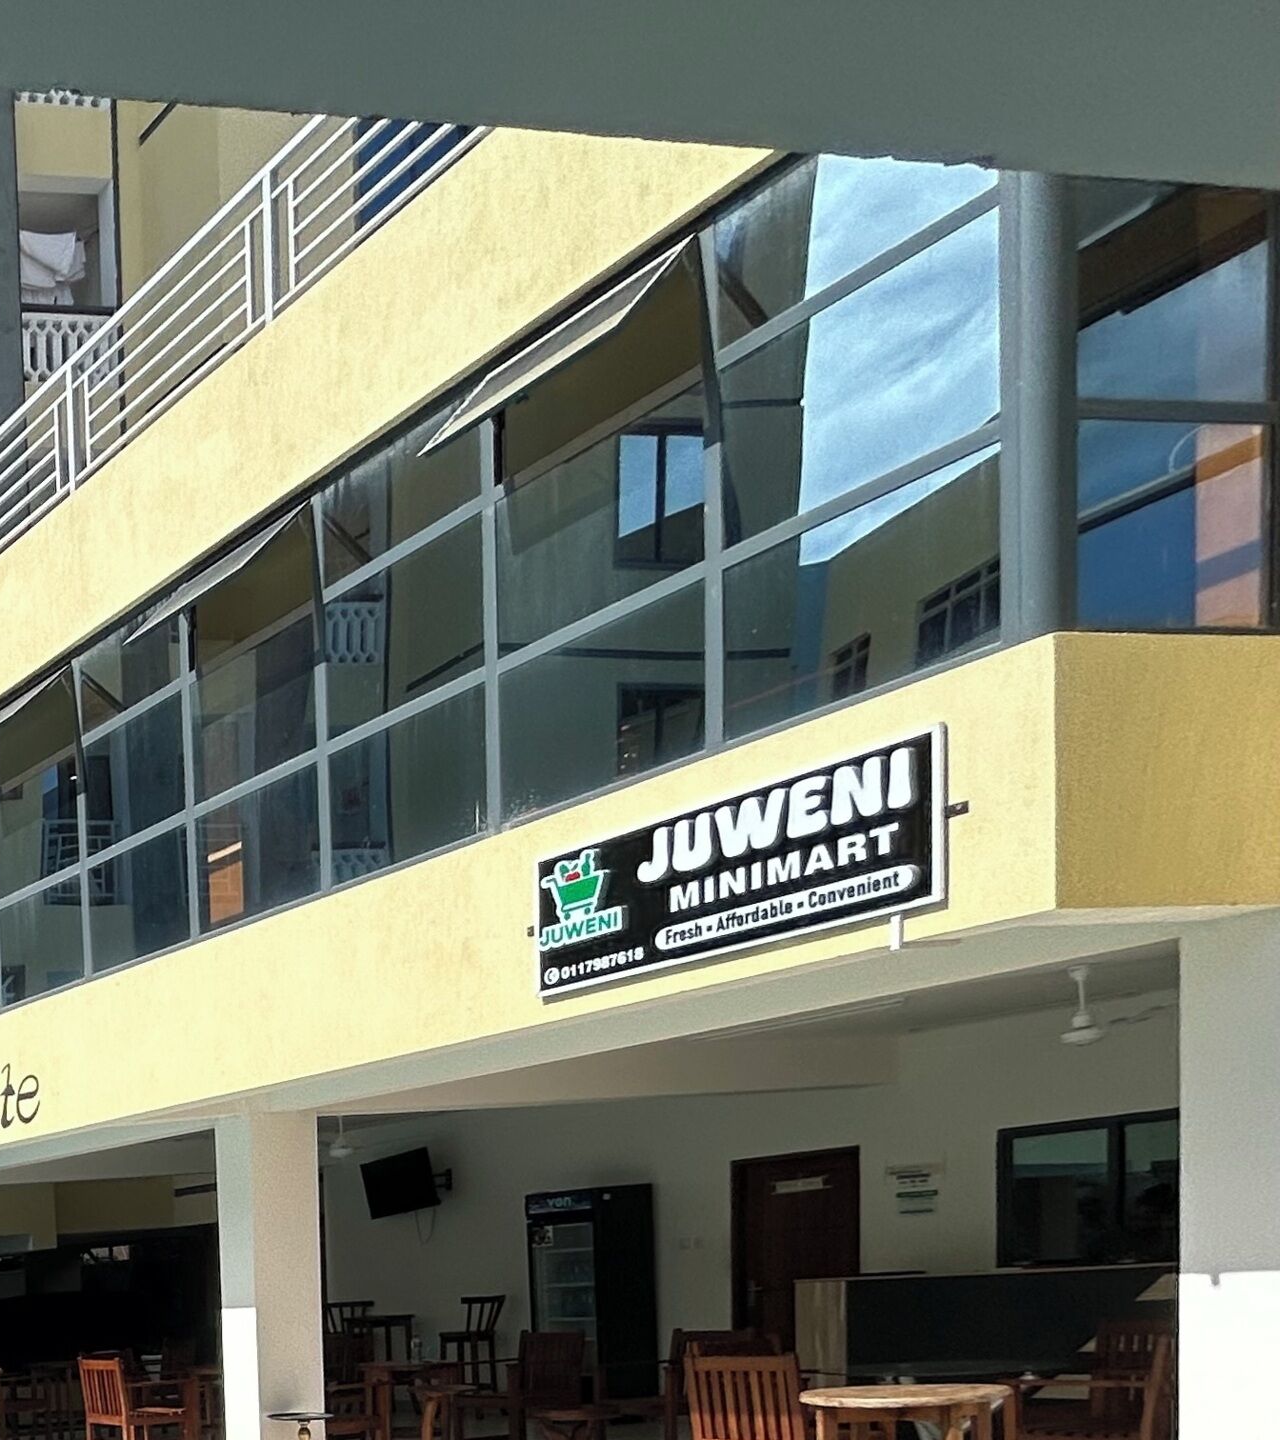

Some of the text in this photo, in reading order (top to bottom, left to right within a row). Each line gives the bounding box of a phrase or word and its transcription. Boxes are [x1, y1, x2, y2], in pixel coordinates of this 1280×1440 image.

[637, 747, 916, 883] JUWENI
[665, 871, 901, 946] Fresh Affordable Convenient
[668, 823, 900, 914] MINIMART
[540, 911, 619, 947] JUWENI
